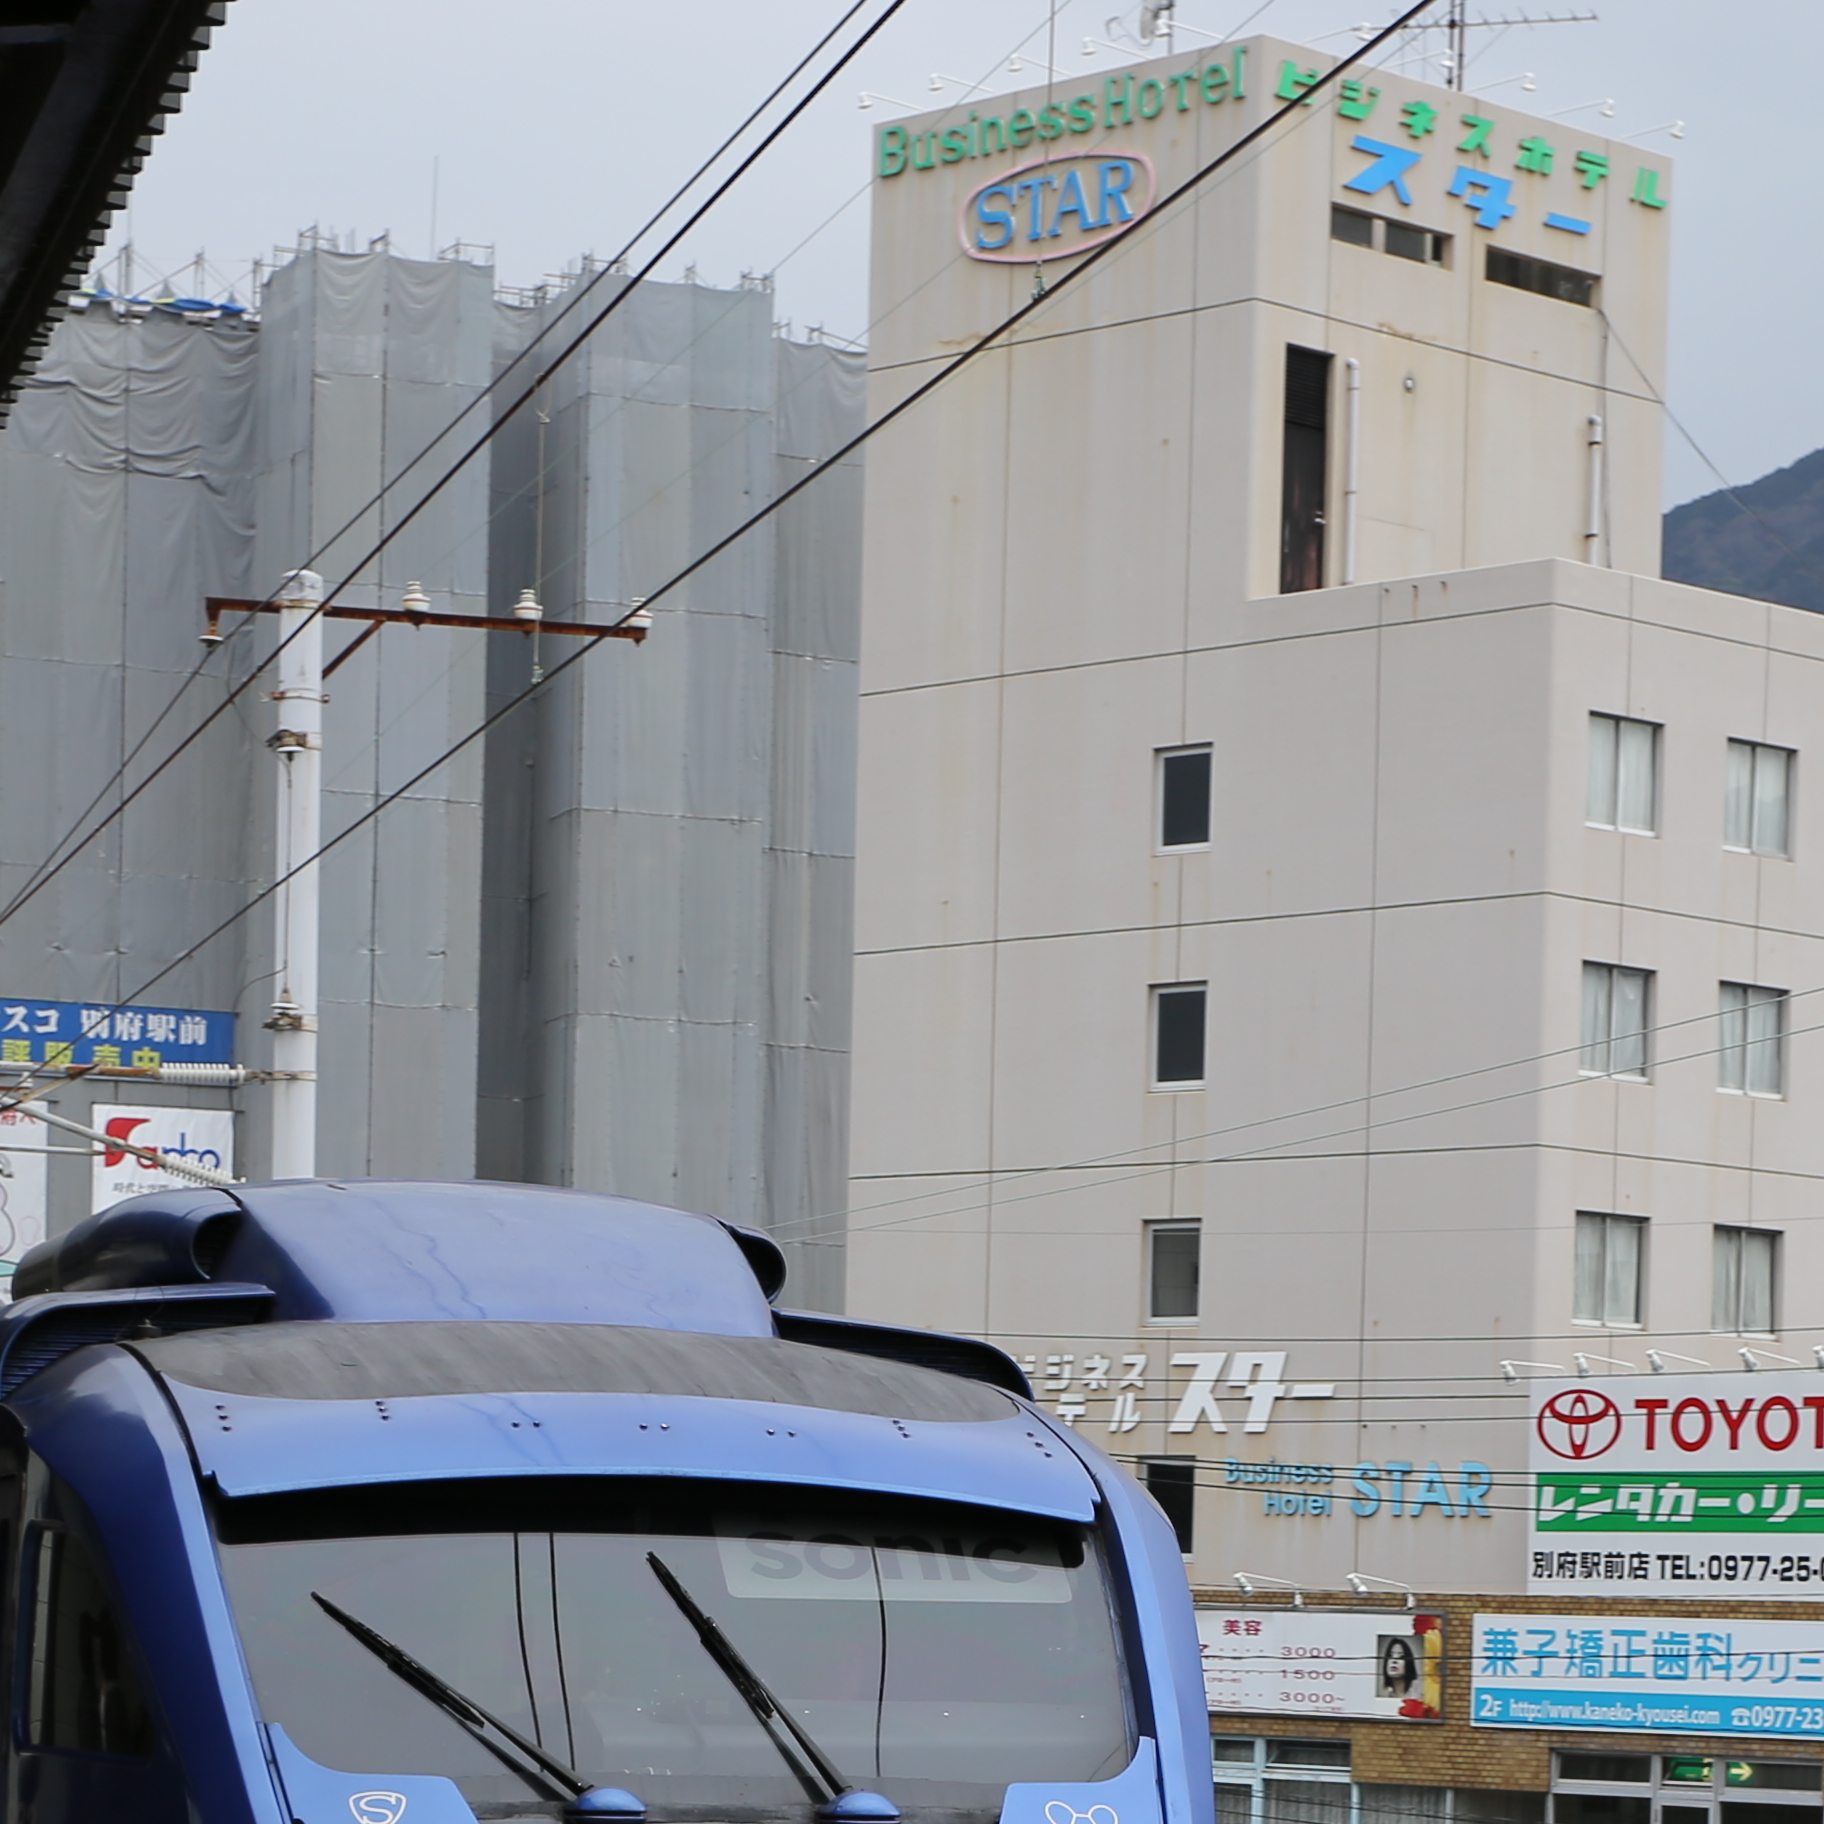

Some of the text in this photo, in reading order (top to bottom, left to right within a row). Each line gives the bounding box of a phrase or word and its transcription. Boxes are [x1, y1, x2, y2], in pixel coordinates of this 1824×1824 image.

[879, 93, 1096, 178] Business
[1275, 60, 1669, 211] ビジネスホテル
[1343, 135, 1594, 236] スター
[975, 159, 1137, 251] STAR
[80, 1008, 208, 1046] 別府駅前
[1167, 1350, 1336, 1434] スター
[1225, 1457, 1333, 1485] Business
[1349, 1460, 1493, 1518] STAR
[1263, 1489, 1333, 1518] Hotel
[745, 1531, 1039, 1584] sonic
[1532, 1551, 1651, 1581] 別府駅前店
[1223, 1620, 1263, 1637] 美容
[1280, 1646, 1337, 1659] 3000
[1280, 1669, 1337, 1682] 1500
[1479, 1694, 1503, 1718] 2F
